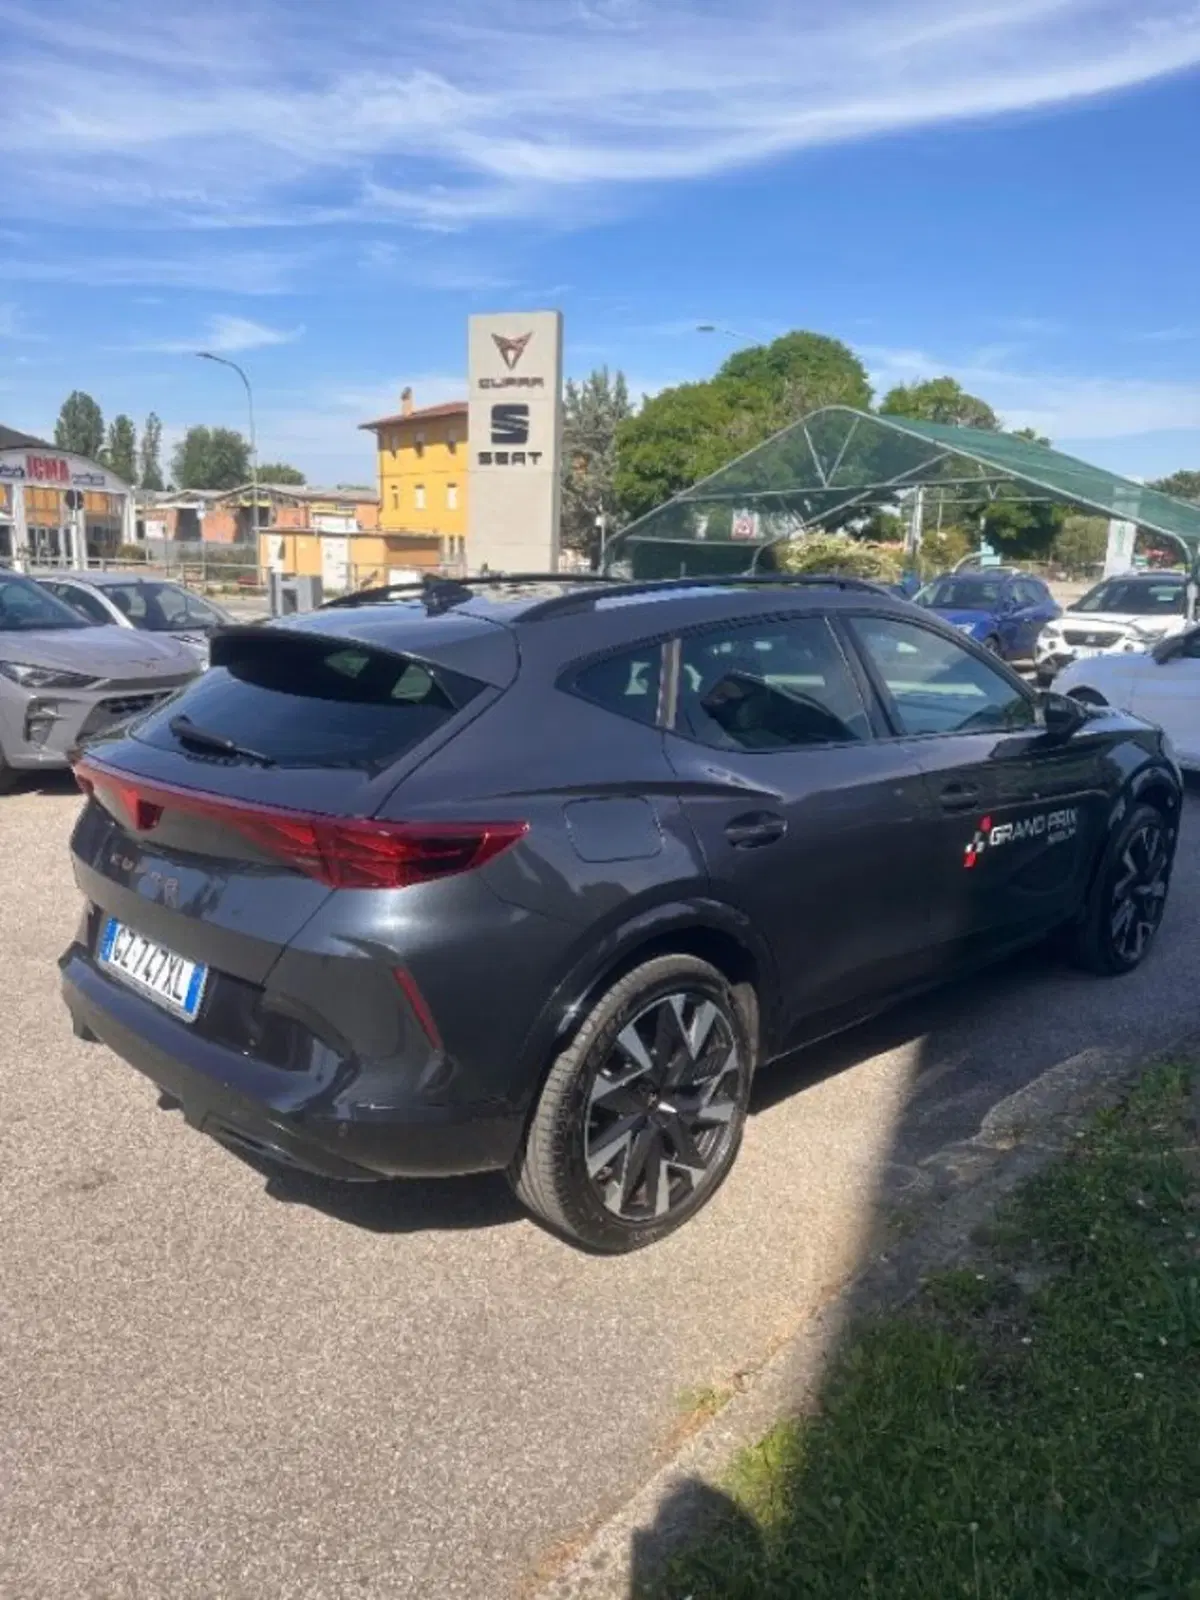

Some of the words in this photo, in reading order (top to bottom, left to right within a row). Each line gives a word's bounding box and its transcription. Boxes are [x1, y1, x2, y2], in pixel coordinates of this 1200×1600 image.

[478, 452, 543, 466] SEAT
[989, 815, 1045, 846] GRAND
[1047, 808, 1079, 831] PRIX
